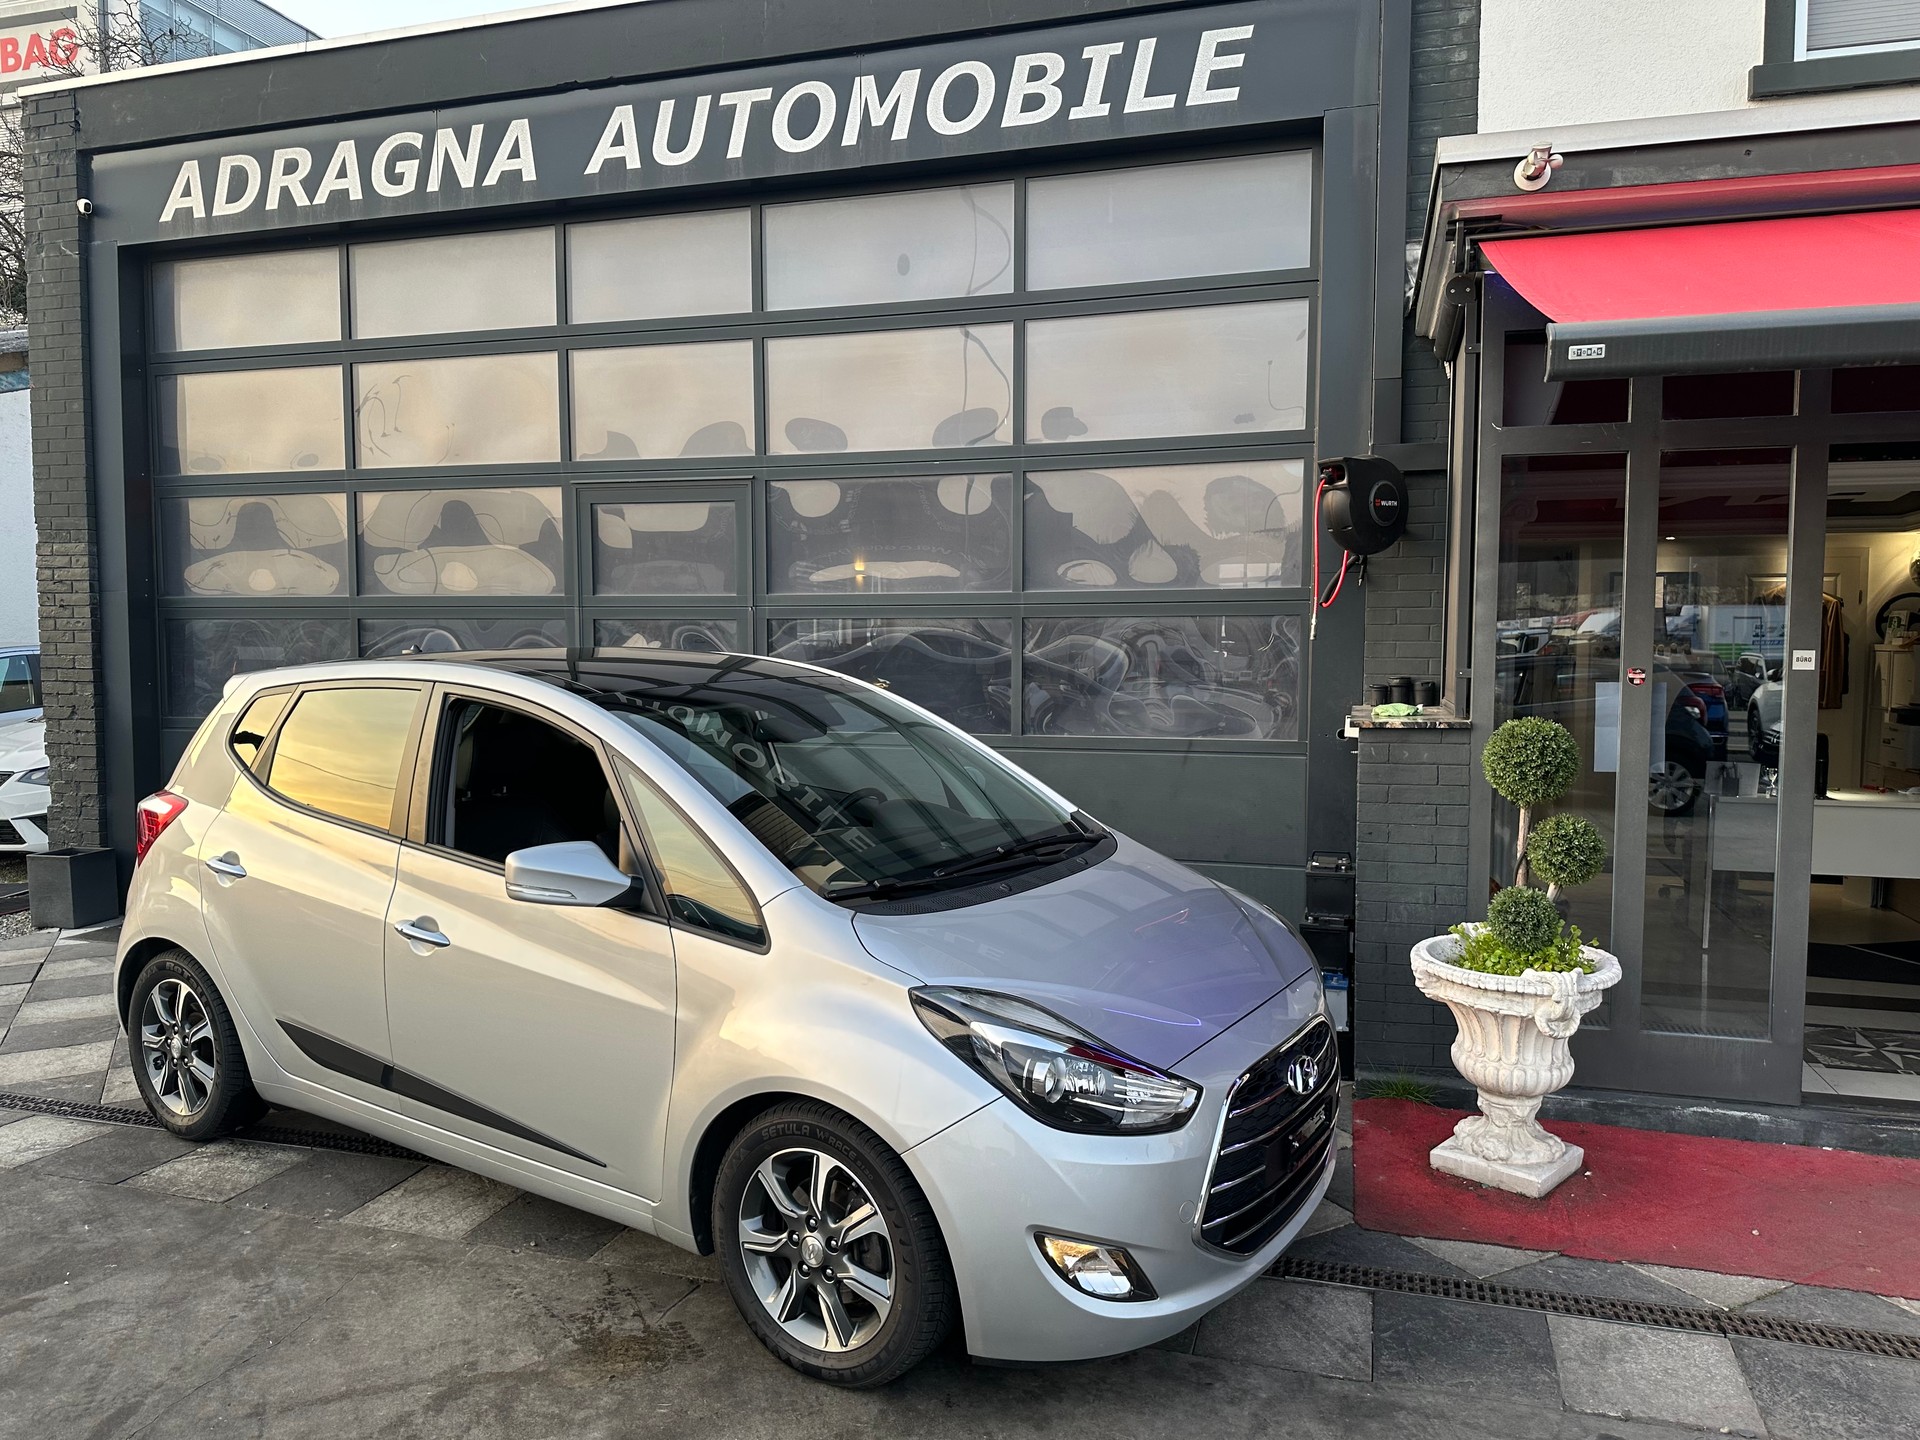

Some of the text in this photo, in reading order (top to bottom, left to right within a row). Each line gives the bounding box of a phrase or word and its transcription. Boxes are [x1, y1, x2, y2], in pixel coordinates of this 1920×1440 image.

[0, 27, 79, 74] BAG
[158, 23, 1255, 223] ADRAGNA AUTOMOBILE
[1571, 348, 1603, 357] STOBAG
[761, 1123, 811, 1141] SETULA
[828, 1135, 858, 1162] RACE
